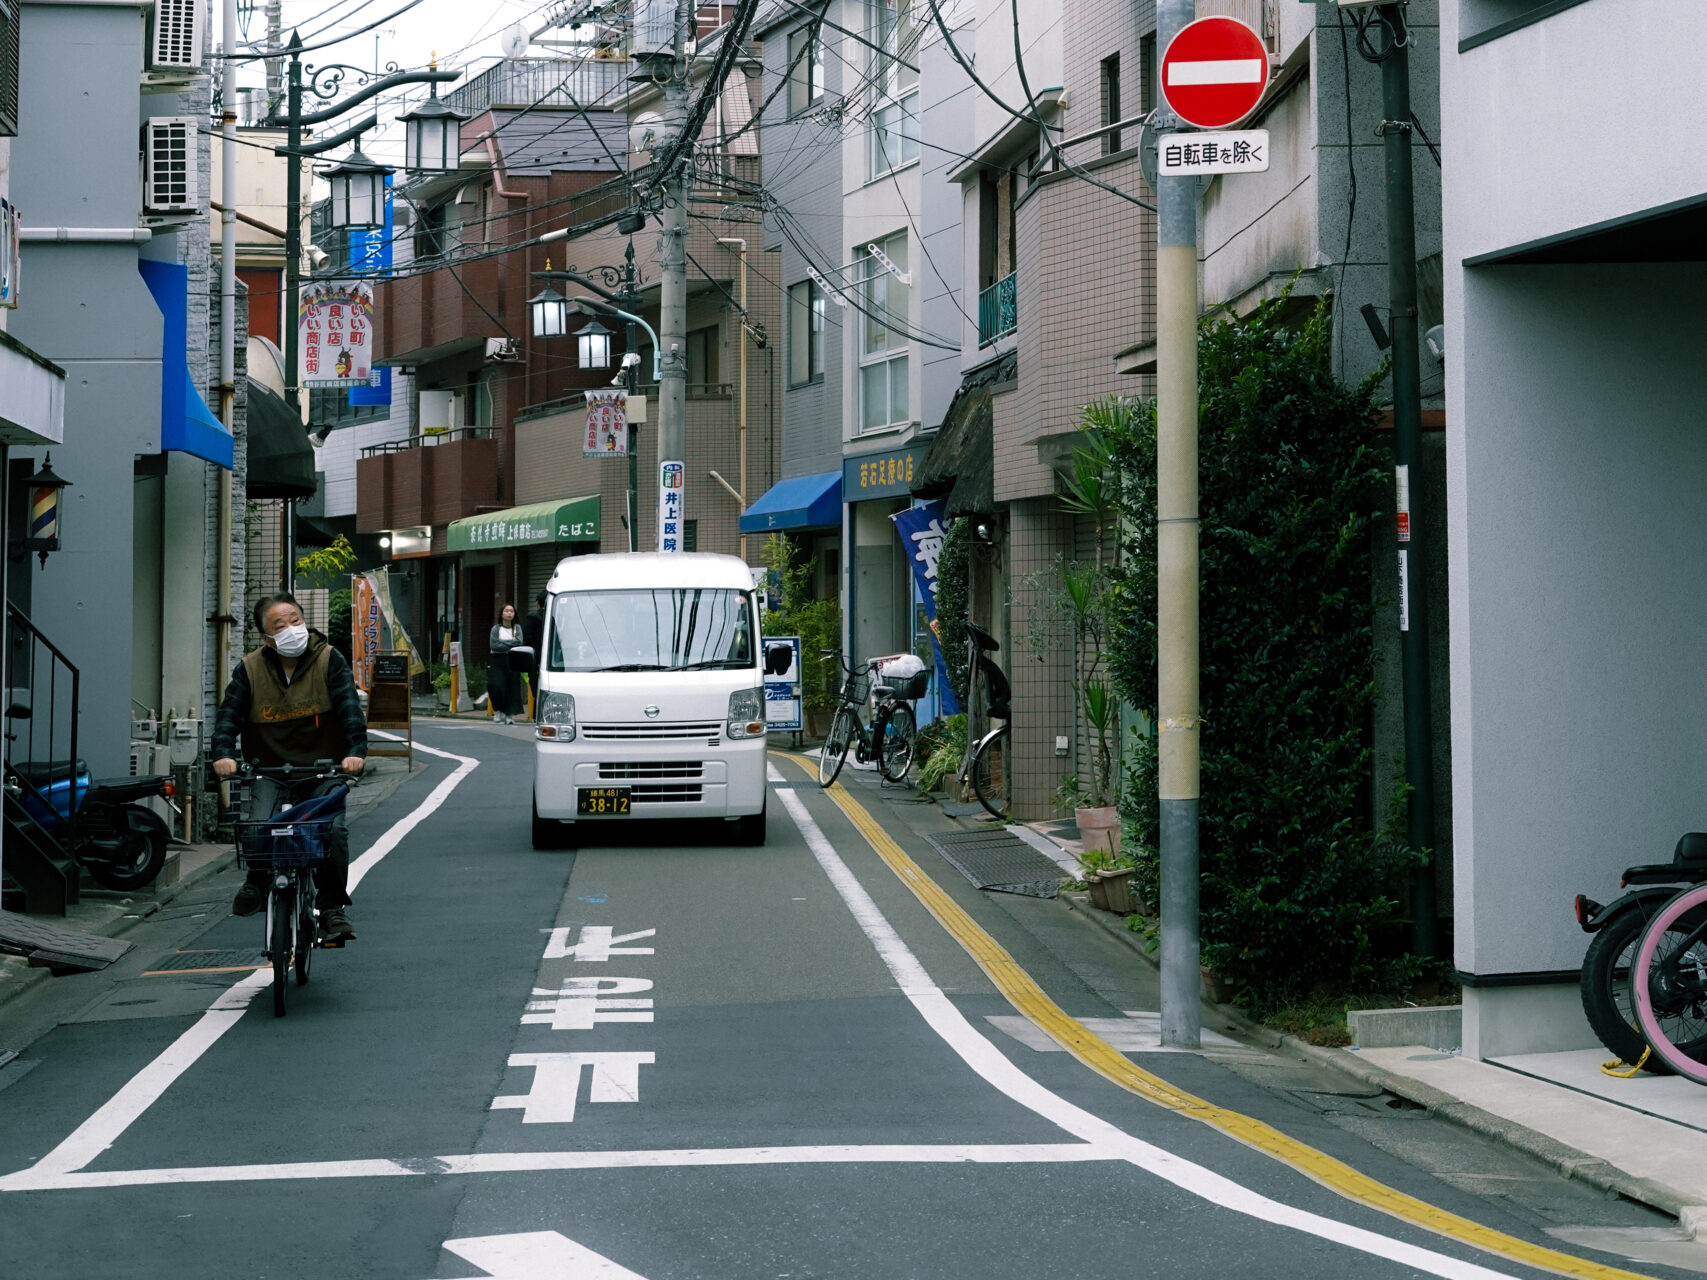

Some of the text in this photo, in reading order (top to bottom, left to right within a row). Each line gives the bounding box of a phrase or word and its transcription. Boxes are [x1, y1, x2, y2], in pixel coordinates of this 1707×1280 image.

[1165, 140, 1263, 167] 自転車を除く
[306, 304, 320, 374] いい商店街
[327, 304, 344, 346] 良い店
[350, 304, 365, 346] いい町
[558, 522, 595, 537] たばこ
[664, 491, 678, 551] 井上医院
[589, 797, 628, 813] 38-12
[606, 789, 618, 797] 481
